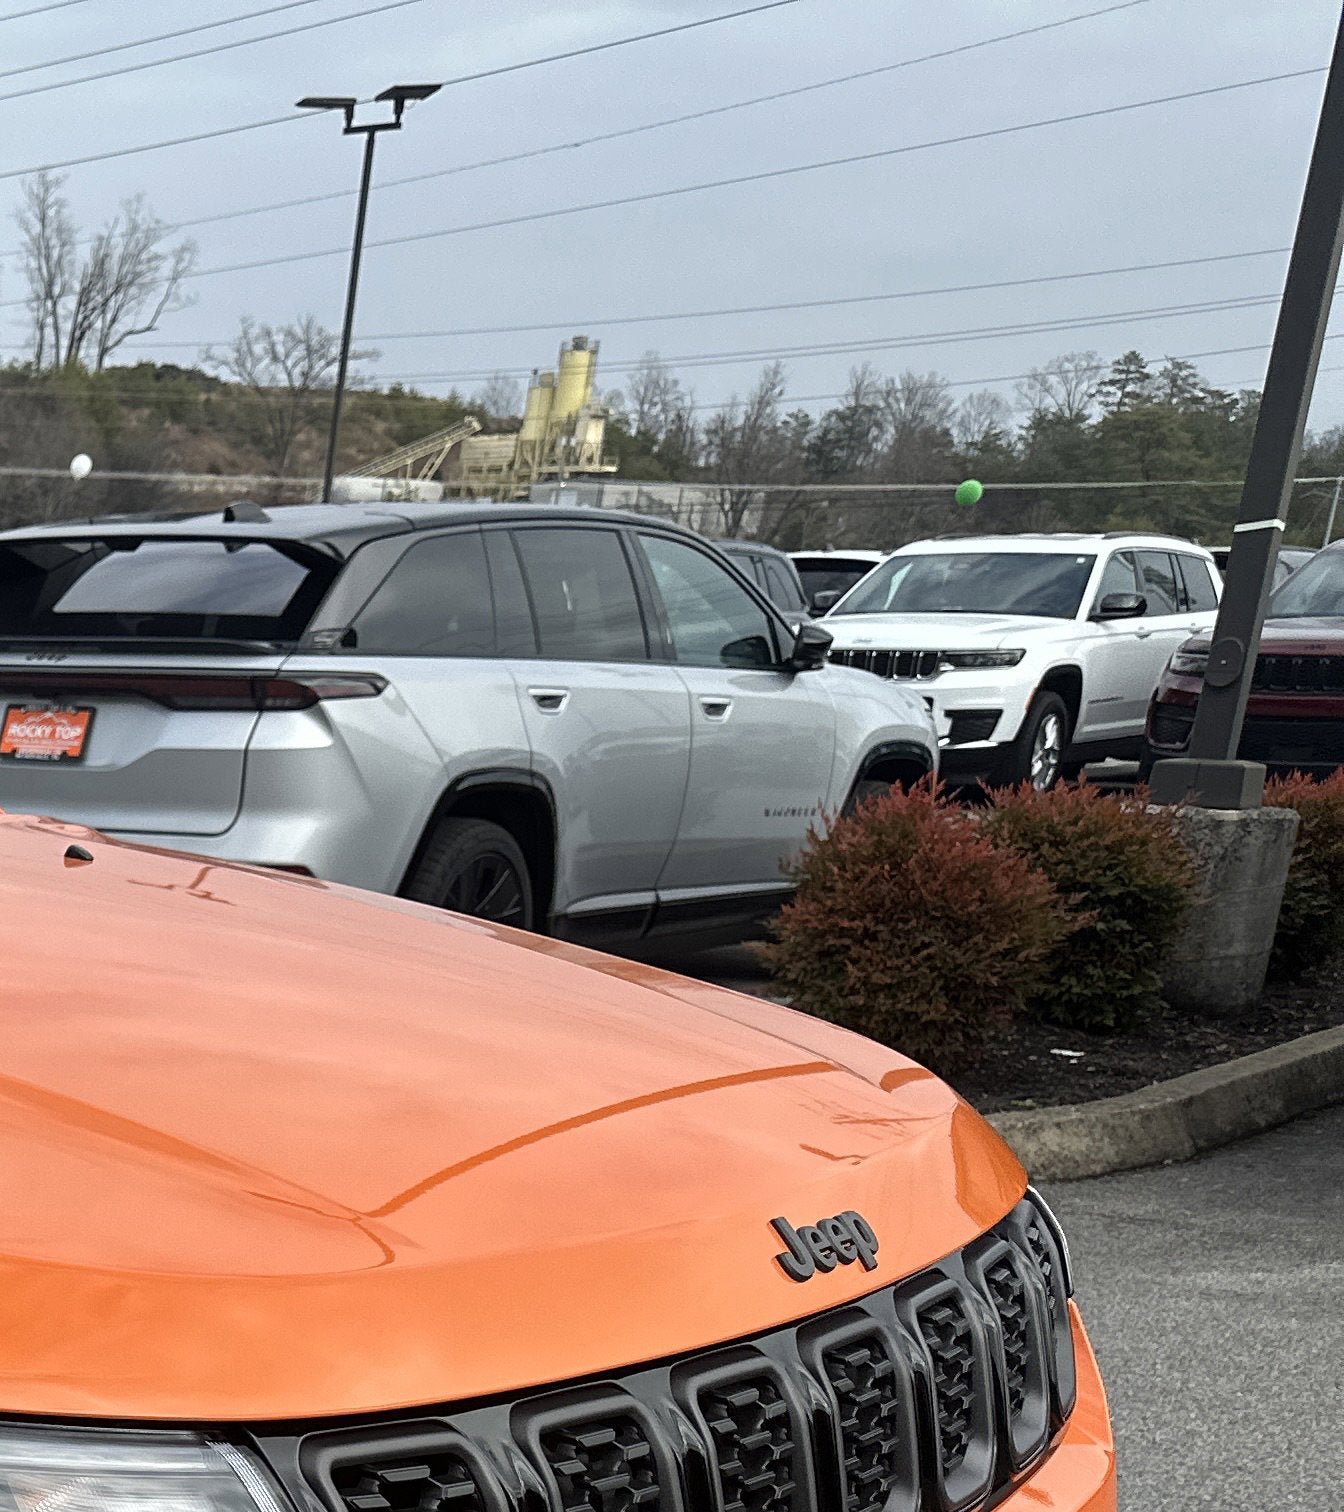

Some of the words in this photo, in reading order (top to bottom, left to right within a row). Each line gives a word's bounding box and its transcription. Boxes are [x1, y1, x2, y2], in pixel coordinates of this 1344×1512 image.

[10, 724, 52, 738] ROCKY
[56, 725, 81, 740] TOP
[769, 1211, 879, 1283] Jeep
